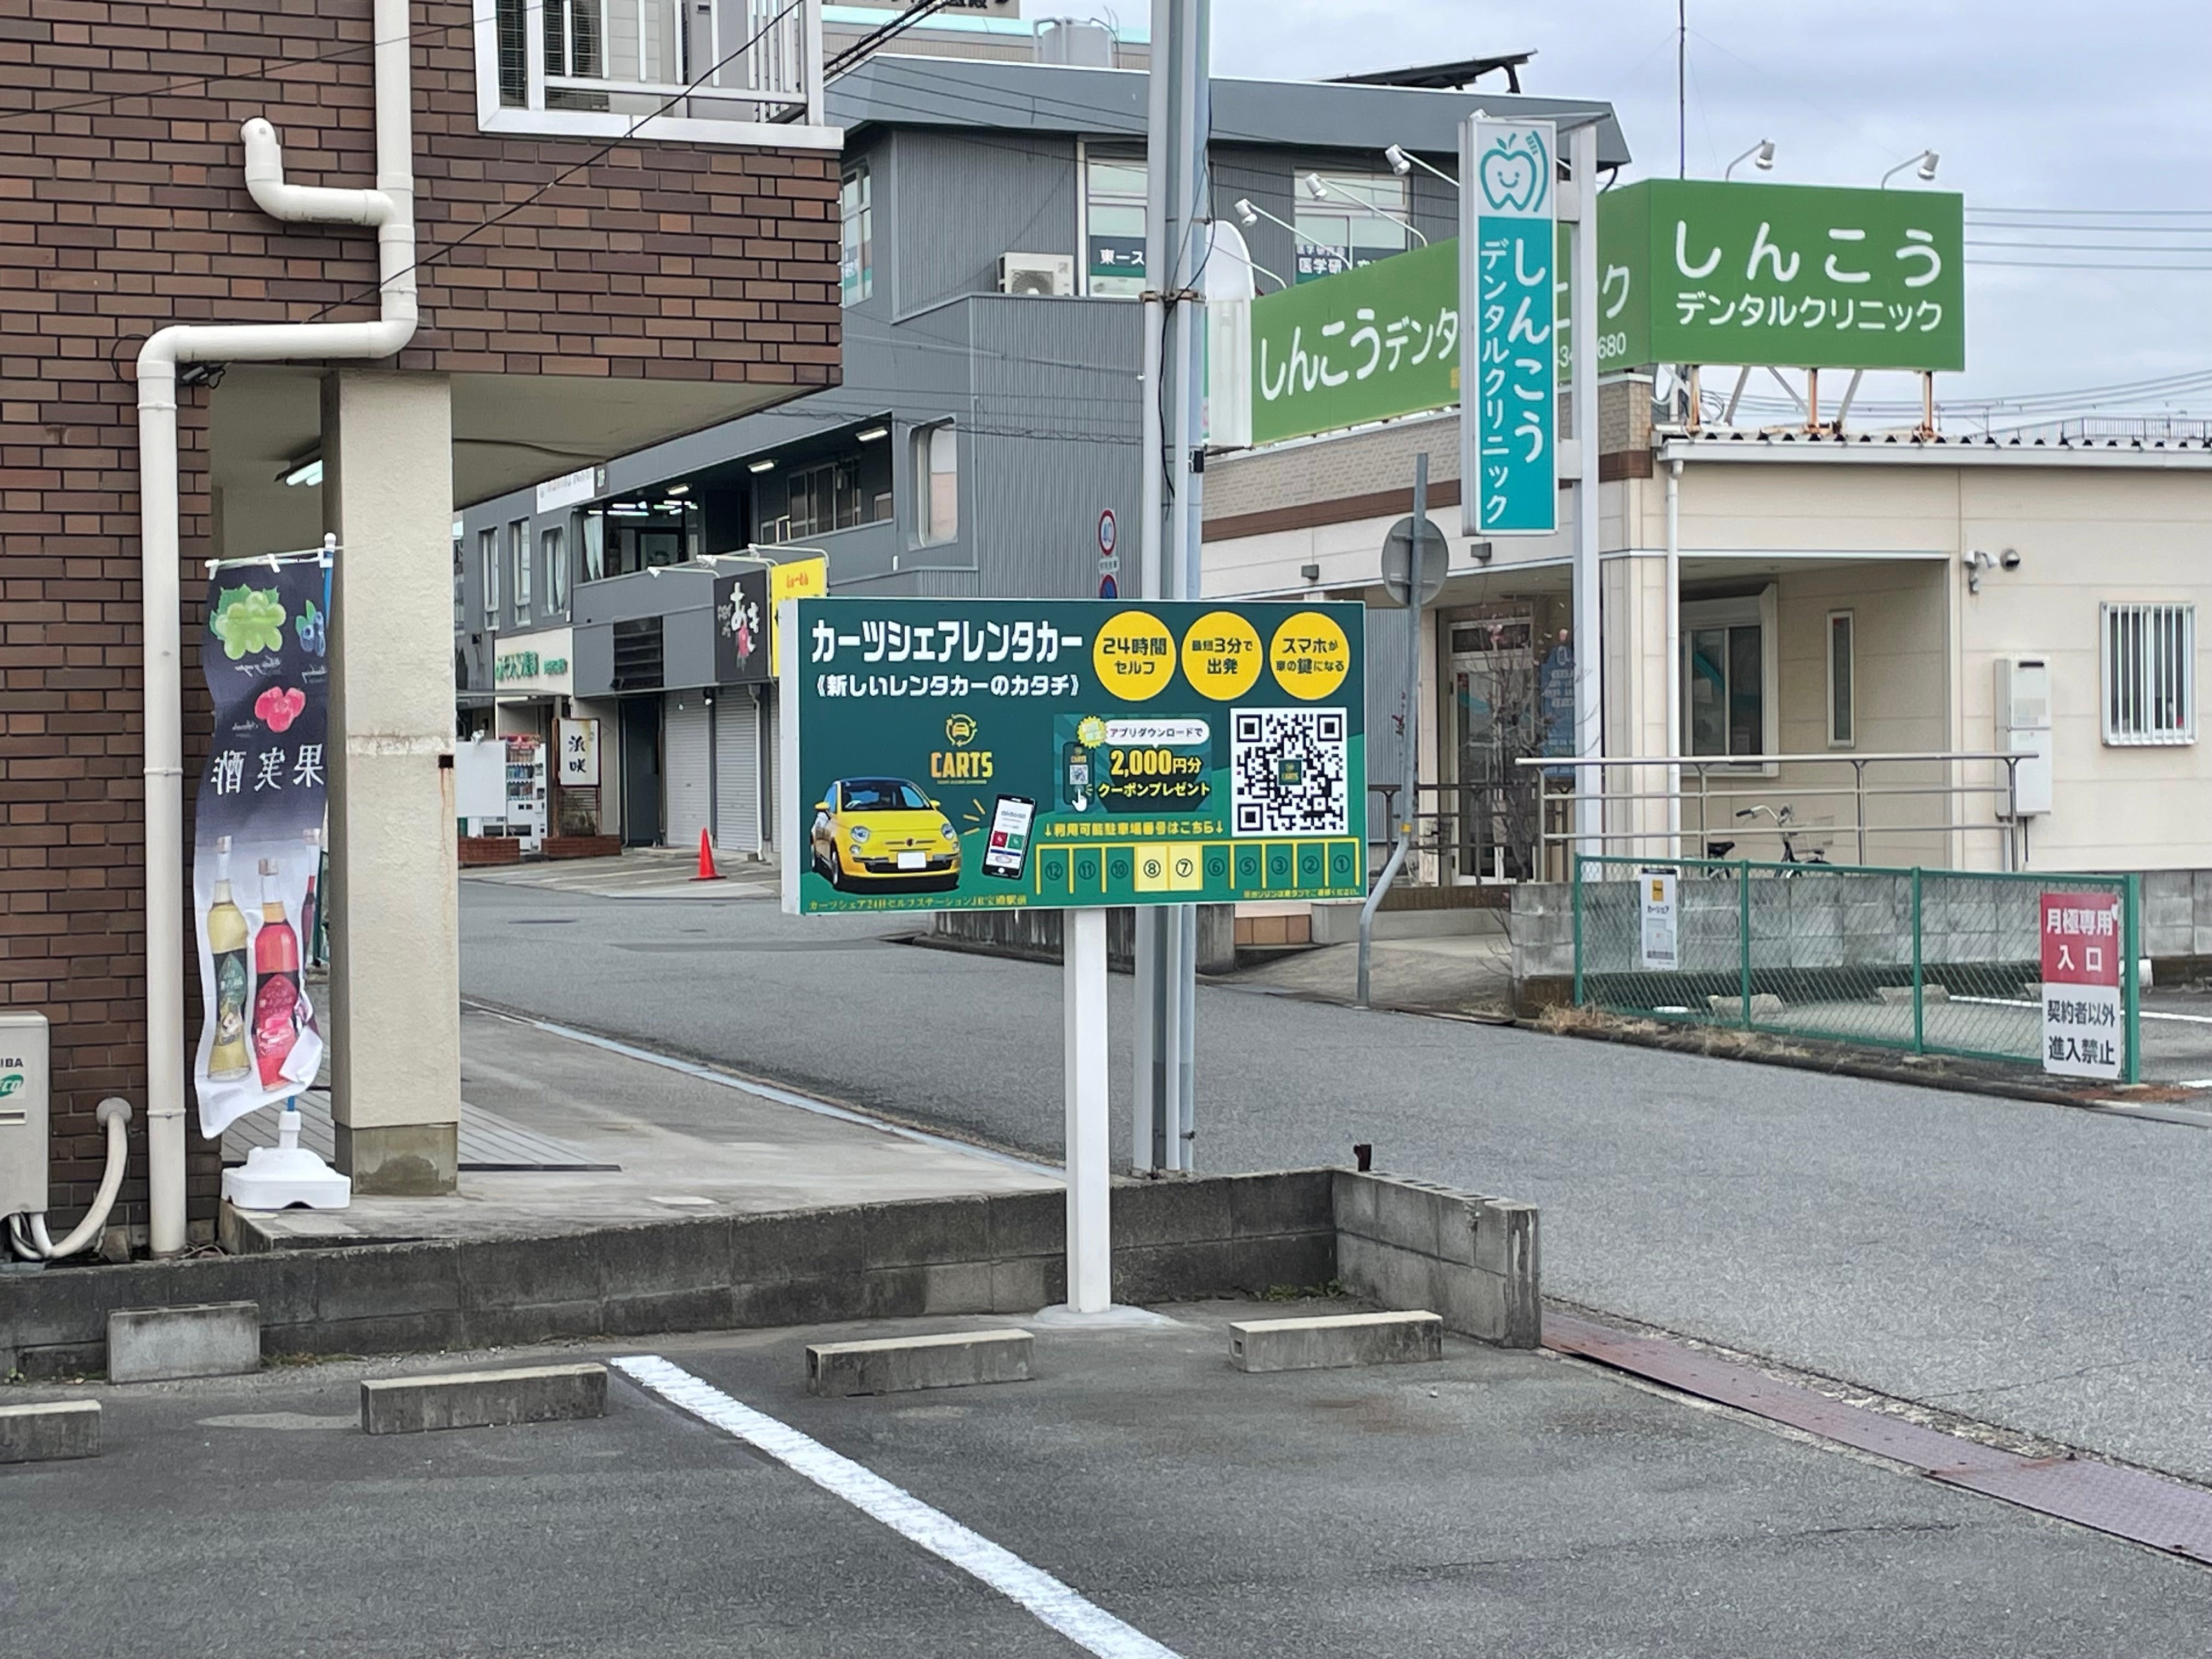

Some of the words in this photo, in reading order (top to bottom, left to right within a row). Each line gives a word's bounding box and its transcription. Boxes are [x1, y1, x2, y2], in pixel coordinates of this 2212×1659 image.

[1675, 220, 1942, 287] しんこう
[1677, 290, 1942, 332] デンタルクリニック
[1508, 238, 1550, 464] しんこう
[1480, 239, 1510, 524] デンタルクリニック
[811, 619, 1083, 663] カーツシェアレンタカー
[1103, 637, 1167, 656] 24時間
[1282, 637, 1338, 654] スマホが
[1114, 662, 1155, 675] セルフ
[1207, 658, 1238, 675] 出発
[1109, 727, 1203, 737] アプリダウンロードで
[930, 752, 994, 778] CARTS
[1110, 749, 1203, 778] 2,000円分
[1098, 781, 1211, 798] クーポンプレゼント
[2047, 908, 2113, 936] 月極専用
[2057, 944, 2102, 972] 入口
[2047, 999, 2115, 1028] 契約者以外
[2048, 1035, 2115, 1065] 進入禁止
